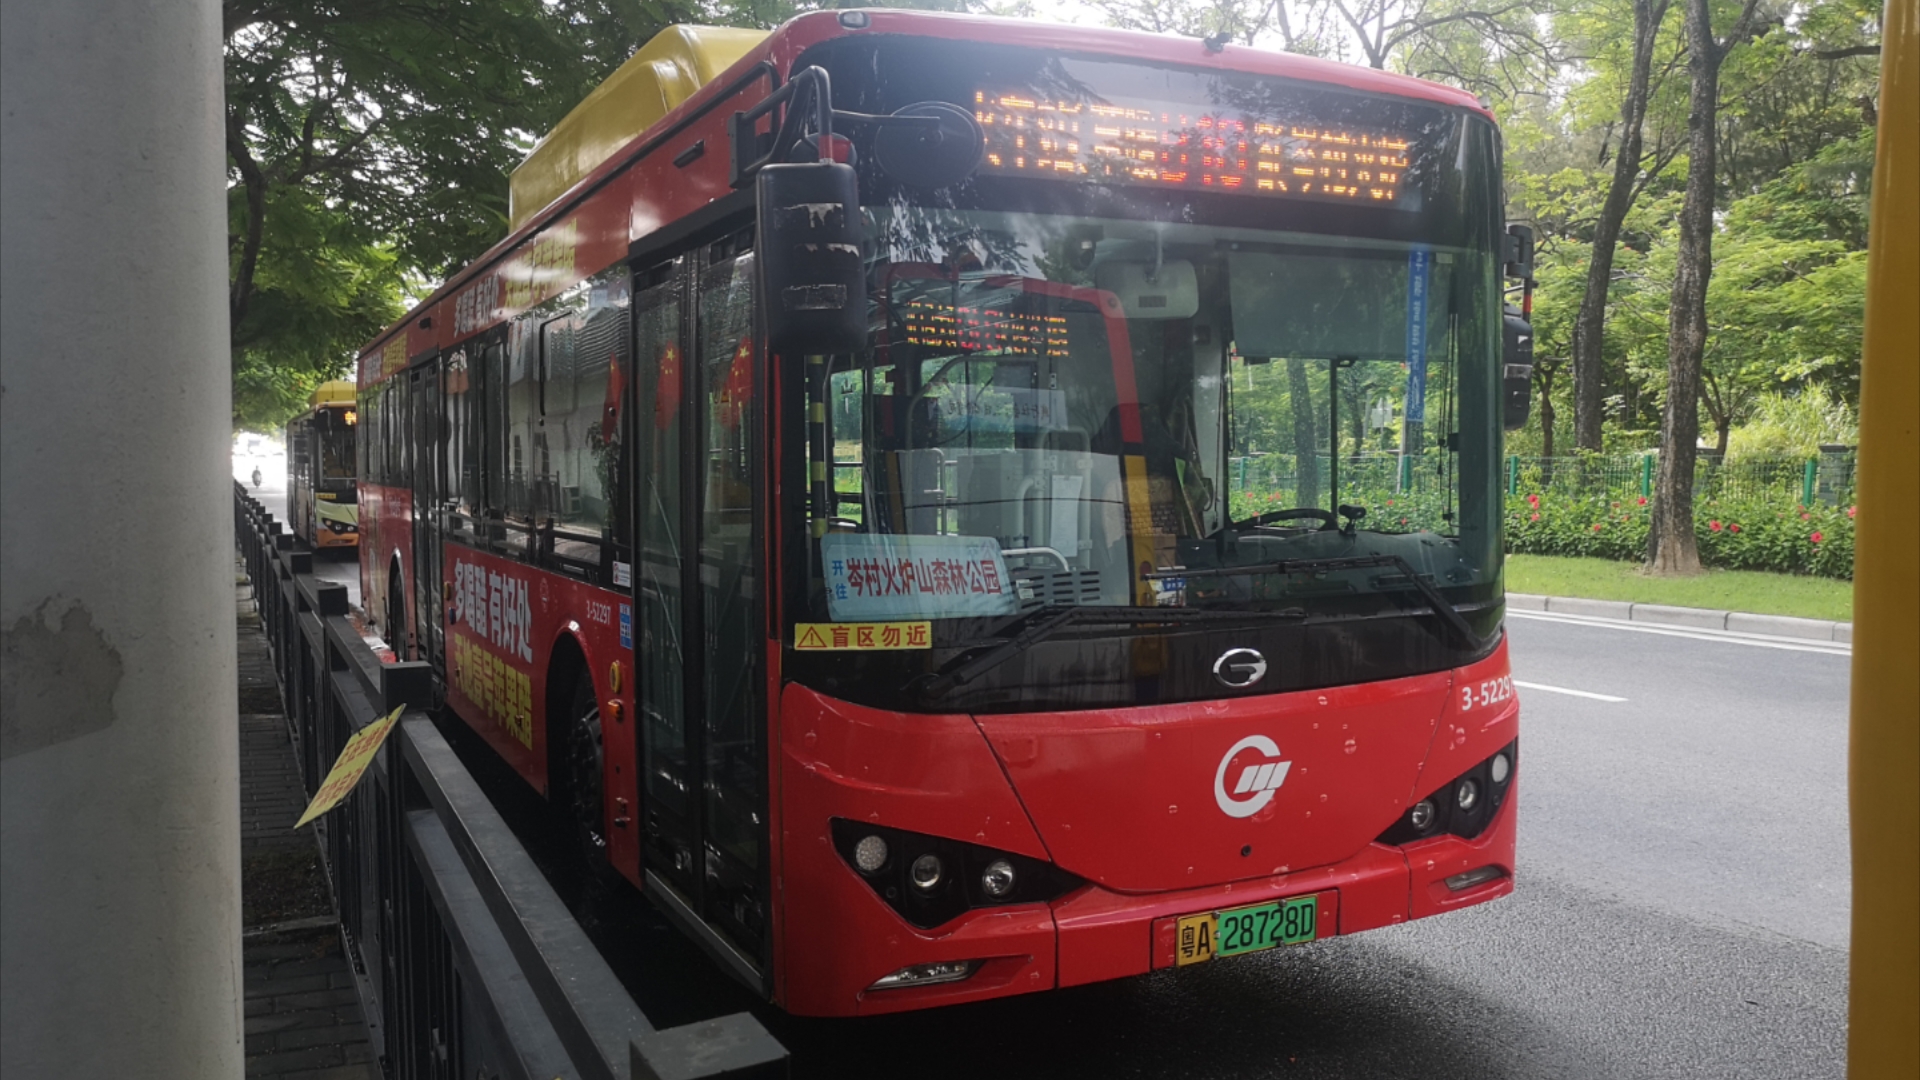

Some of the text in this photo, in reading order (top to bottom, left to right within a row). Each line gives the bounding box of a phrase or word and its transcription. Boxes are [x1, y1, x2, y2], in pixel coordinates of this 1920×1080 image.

[832, 558, 1002, 600] 开往 岑村火炉山森林公园
[455, 558, 487, 638] 多喝醋
[489, 569, 532, 664] 有好处
[586, 600, 611, 625] 3-52297
[830, 625, 927, 648] 盲区勿近
